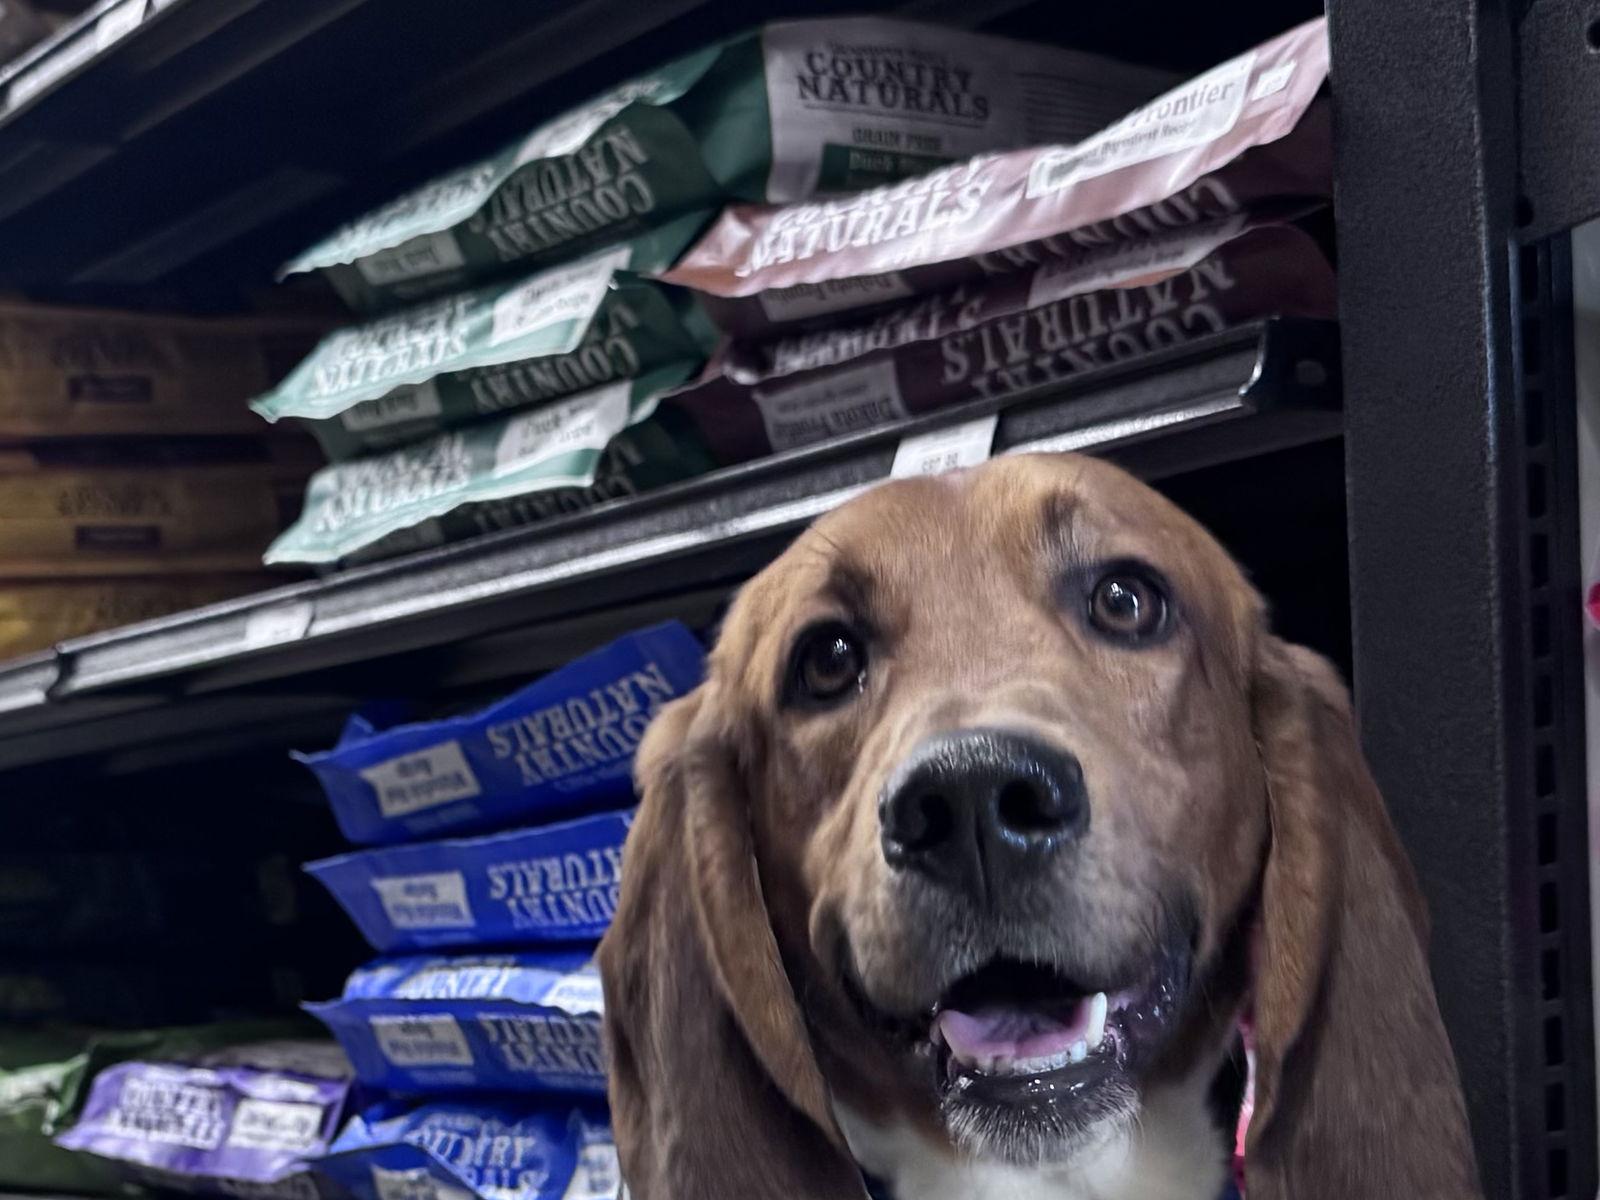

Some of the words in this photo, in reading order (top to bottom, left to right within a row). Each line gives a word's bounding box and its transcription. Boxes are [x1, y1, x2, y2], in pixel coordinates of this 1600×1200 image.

[796, 73, 991, 121] NATURALS
[805, 50, 974, 92] COUNTRY
[488, 172, 656, 262] COUNTRY
[738, 175, 994, 277] NATURALS
[941, 256, 1236, 385] NATURALS
[486, 663, 676, 759] NATURALS
[513, 714, 650, 788] OUNTRY
[486, 843, 627, 900] ATURALS
